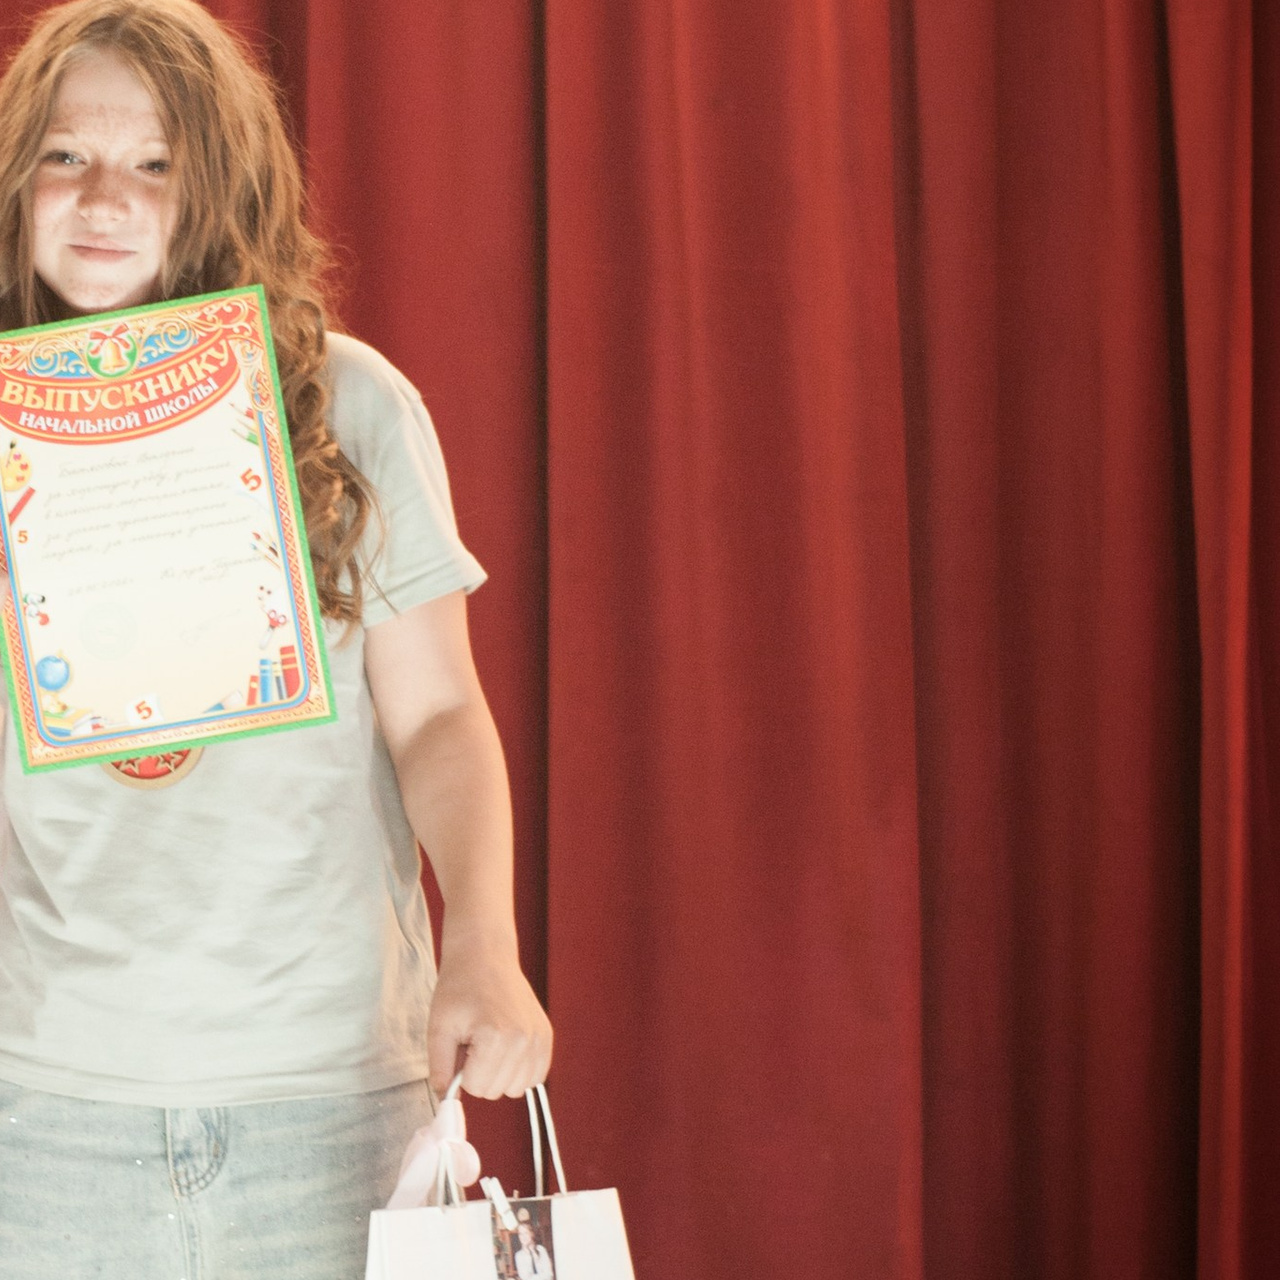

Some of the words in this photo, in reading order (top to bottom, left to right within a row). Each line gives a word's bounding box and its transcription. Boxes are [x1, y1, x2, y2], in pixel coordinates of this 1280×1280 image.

[0, 338, 229, 413] ВЫПУСКНИКУ
[19, 410, 141, 435] НАЧАЛЬНОЙ
[146, 378, 220, 424] ШКОЛЫ
[240, 468, 262, 492] 5
[17, 530, 29, 544] 5
[135, 701, 153, 720] 5
